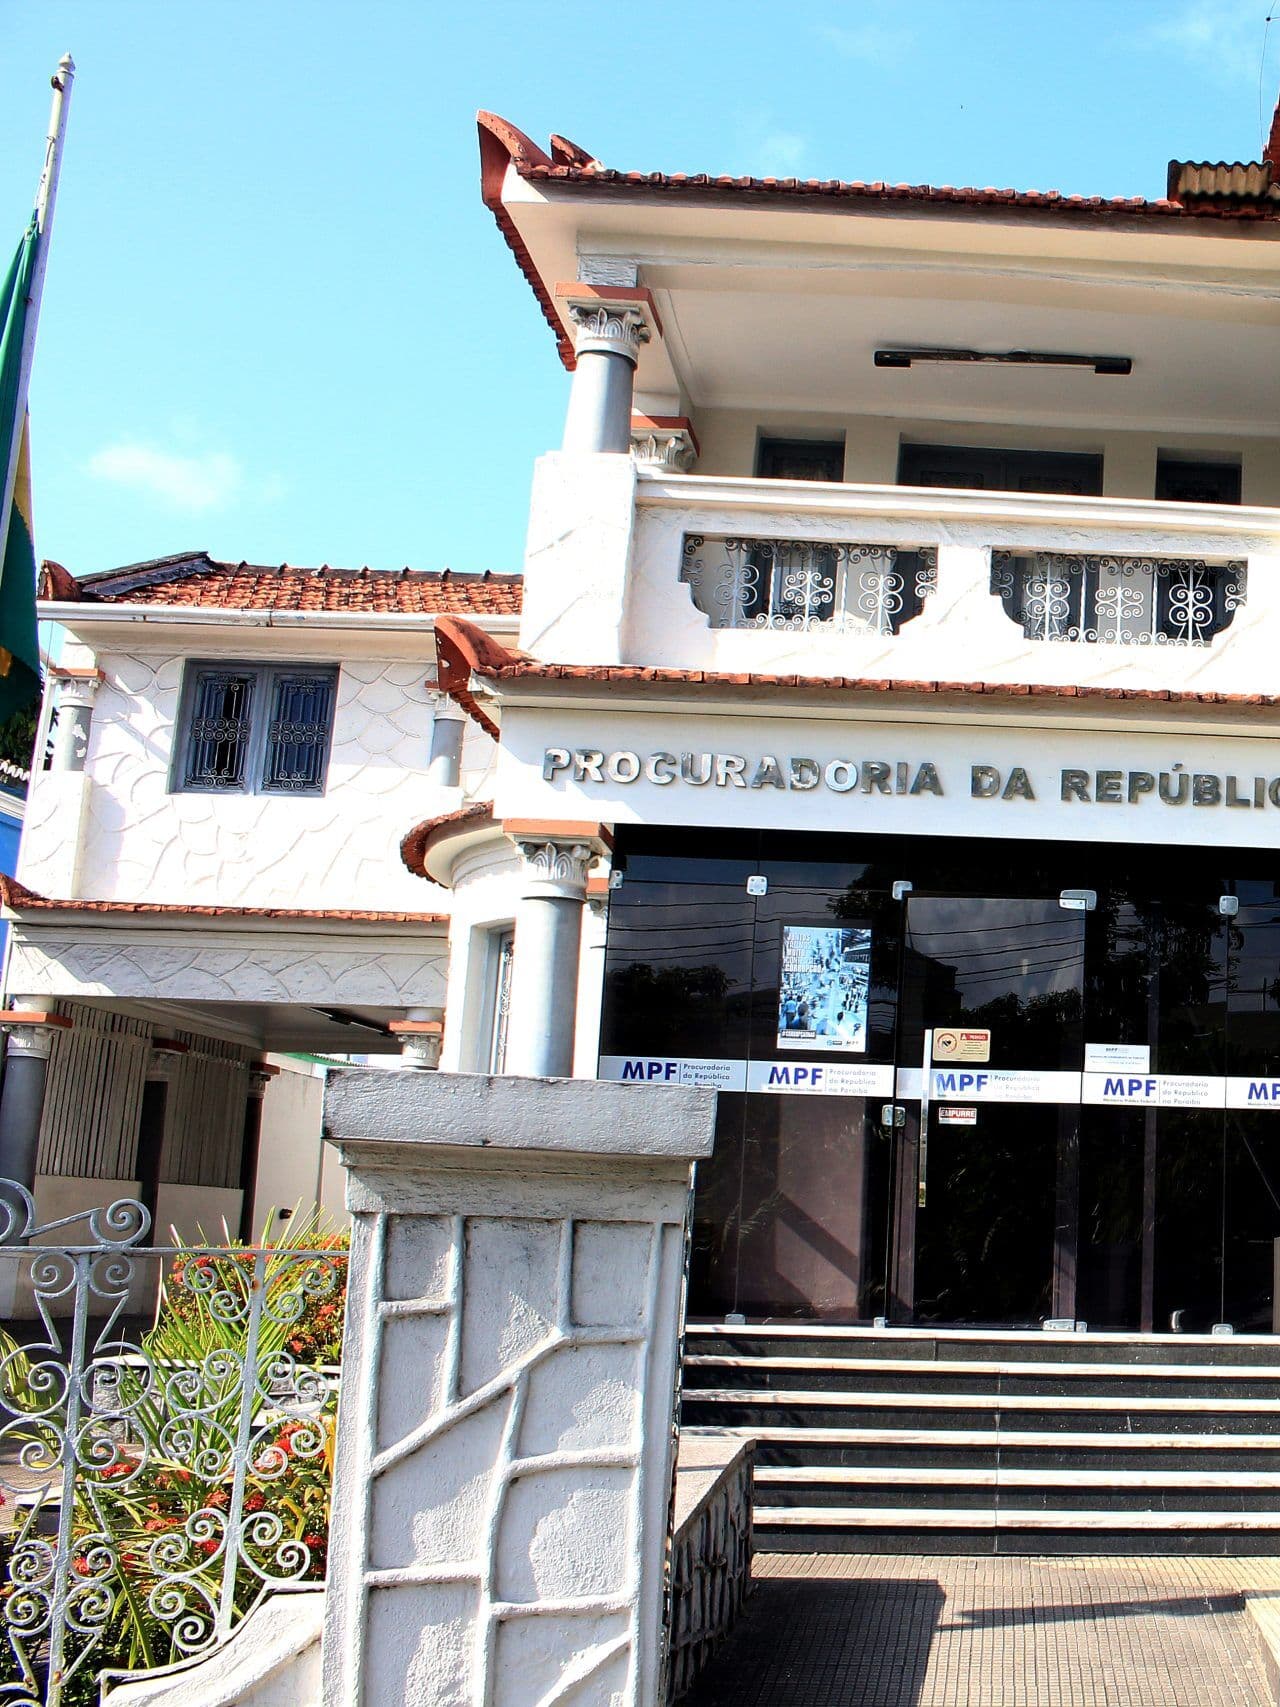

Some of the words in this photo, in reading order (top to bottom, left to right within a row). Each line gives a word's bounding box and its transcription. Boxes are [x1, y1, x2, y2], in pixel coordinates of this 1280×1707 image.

[543, 748, 945, 797] PROCURADORIA
[971, 764, 1035, 800] DA
[622, 1061, 677, 1080] MPF
[768, 1066, 823, 1086] MPF
[829, 1068, 876, 1076] Procuradoria
[936, 1073, 989, 1092] MPF
[1103, 1078, 1157, 1097] MPF
[1162, 1080, 1209, 1088] Procuradoria
